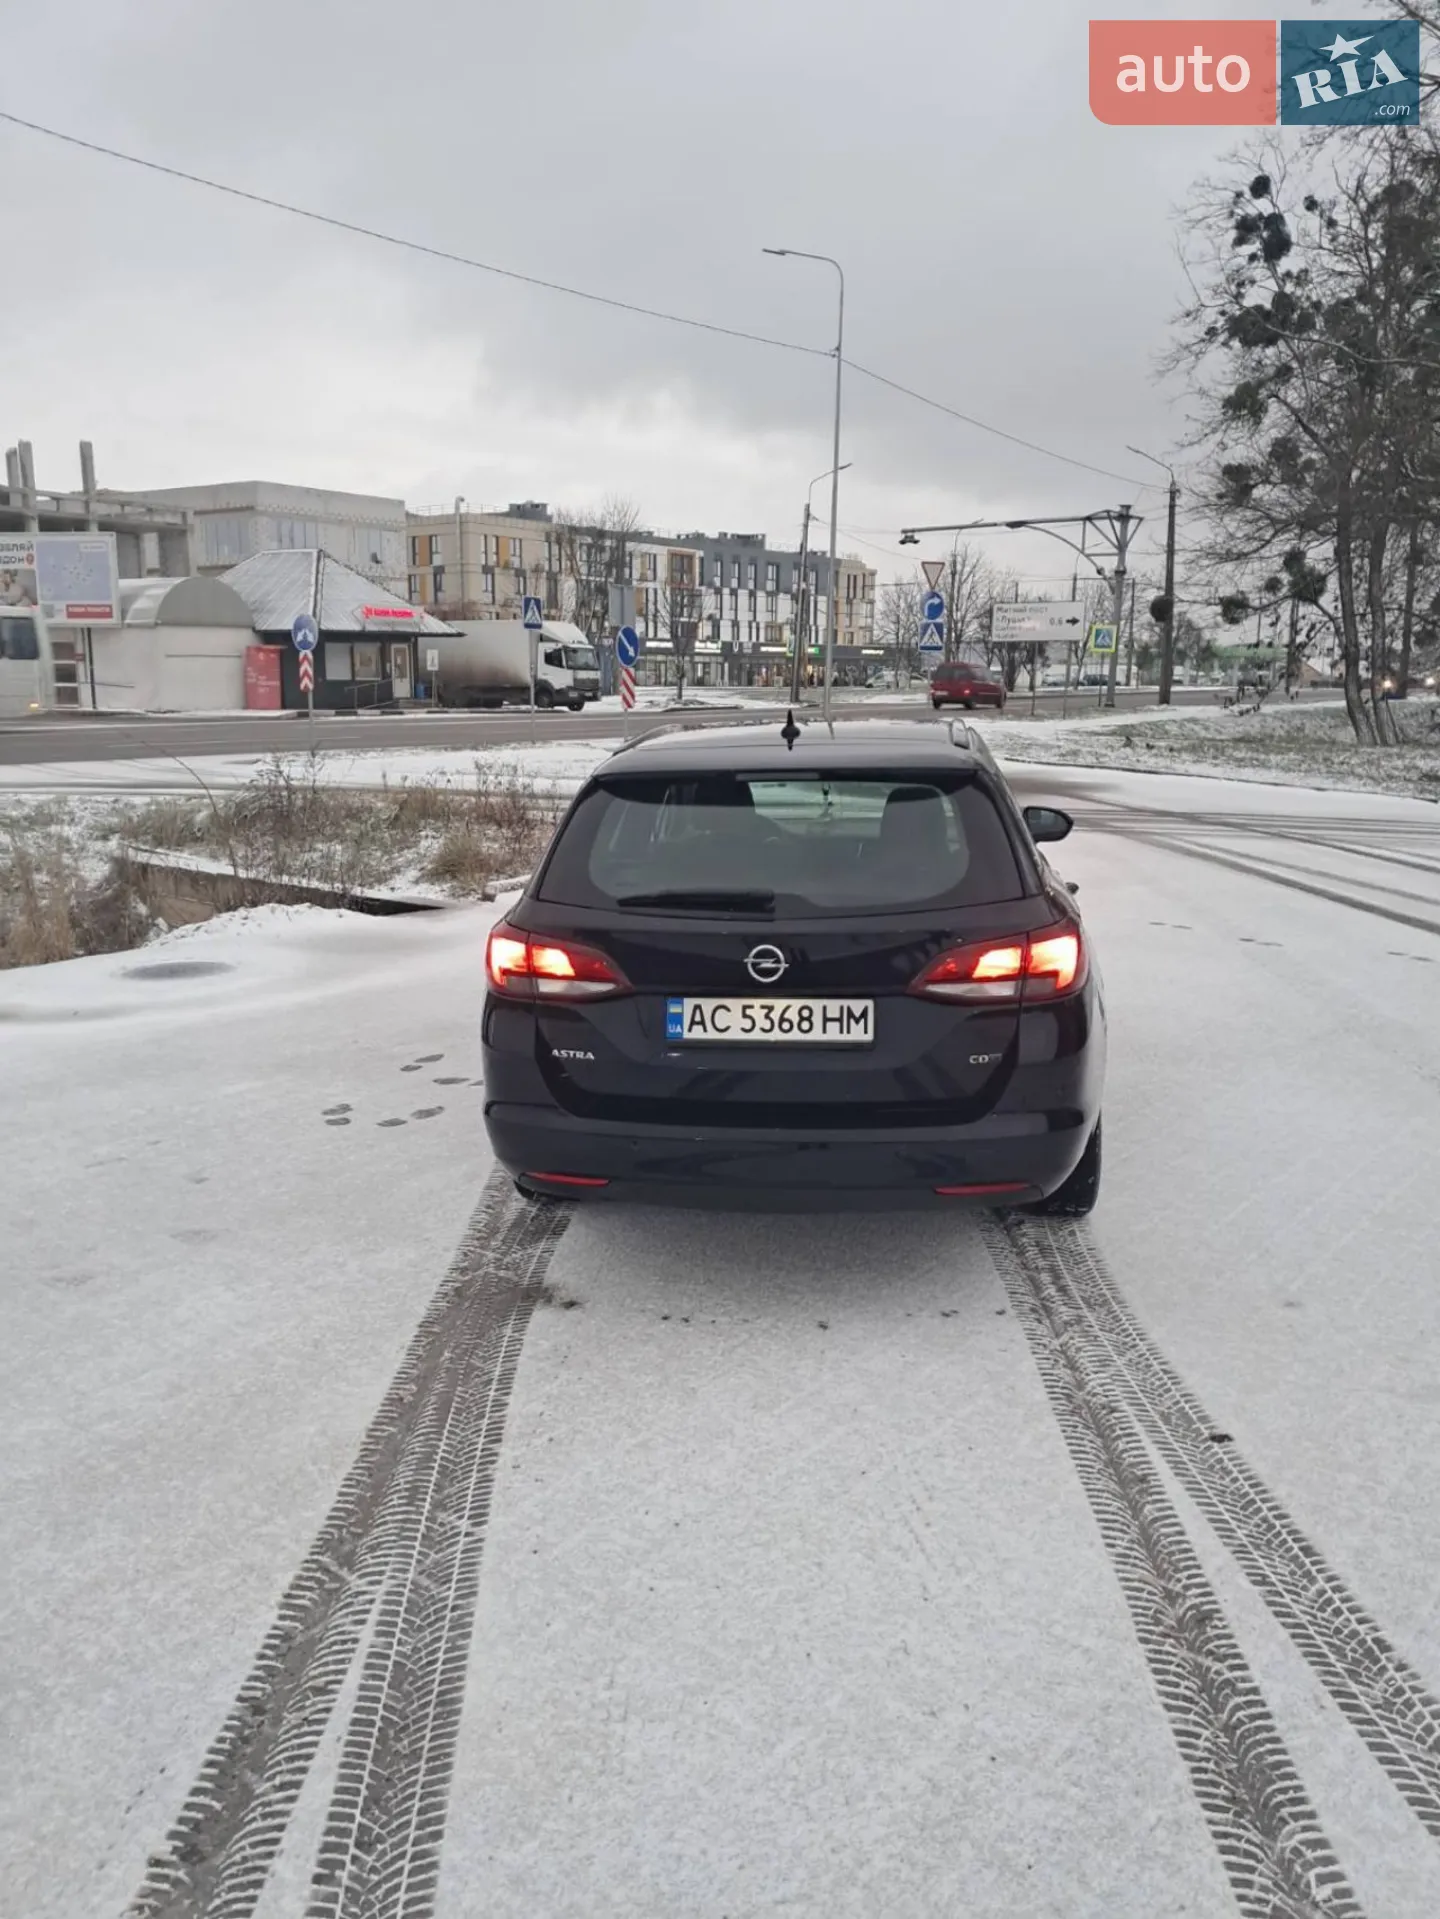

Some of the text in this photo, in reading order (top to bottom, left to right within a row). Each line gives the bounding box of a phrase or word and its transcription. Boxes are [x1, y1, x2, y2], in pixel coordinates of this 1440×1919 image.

[687, 1004, 869, 1034] AC 5368 HM
[668, 1025, 683, 1033] UA
[552, 1049, 595, 1060] ASTRA
